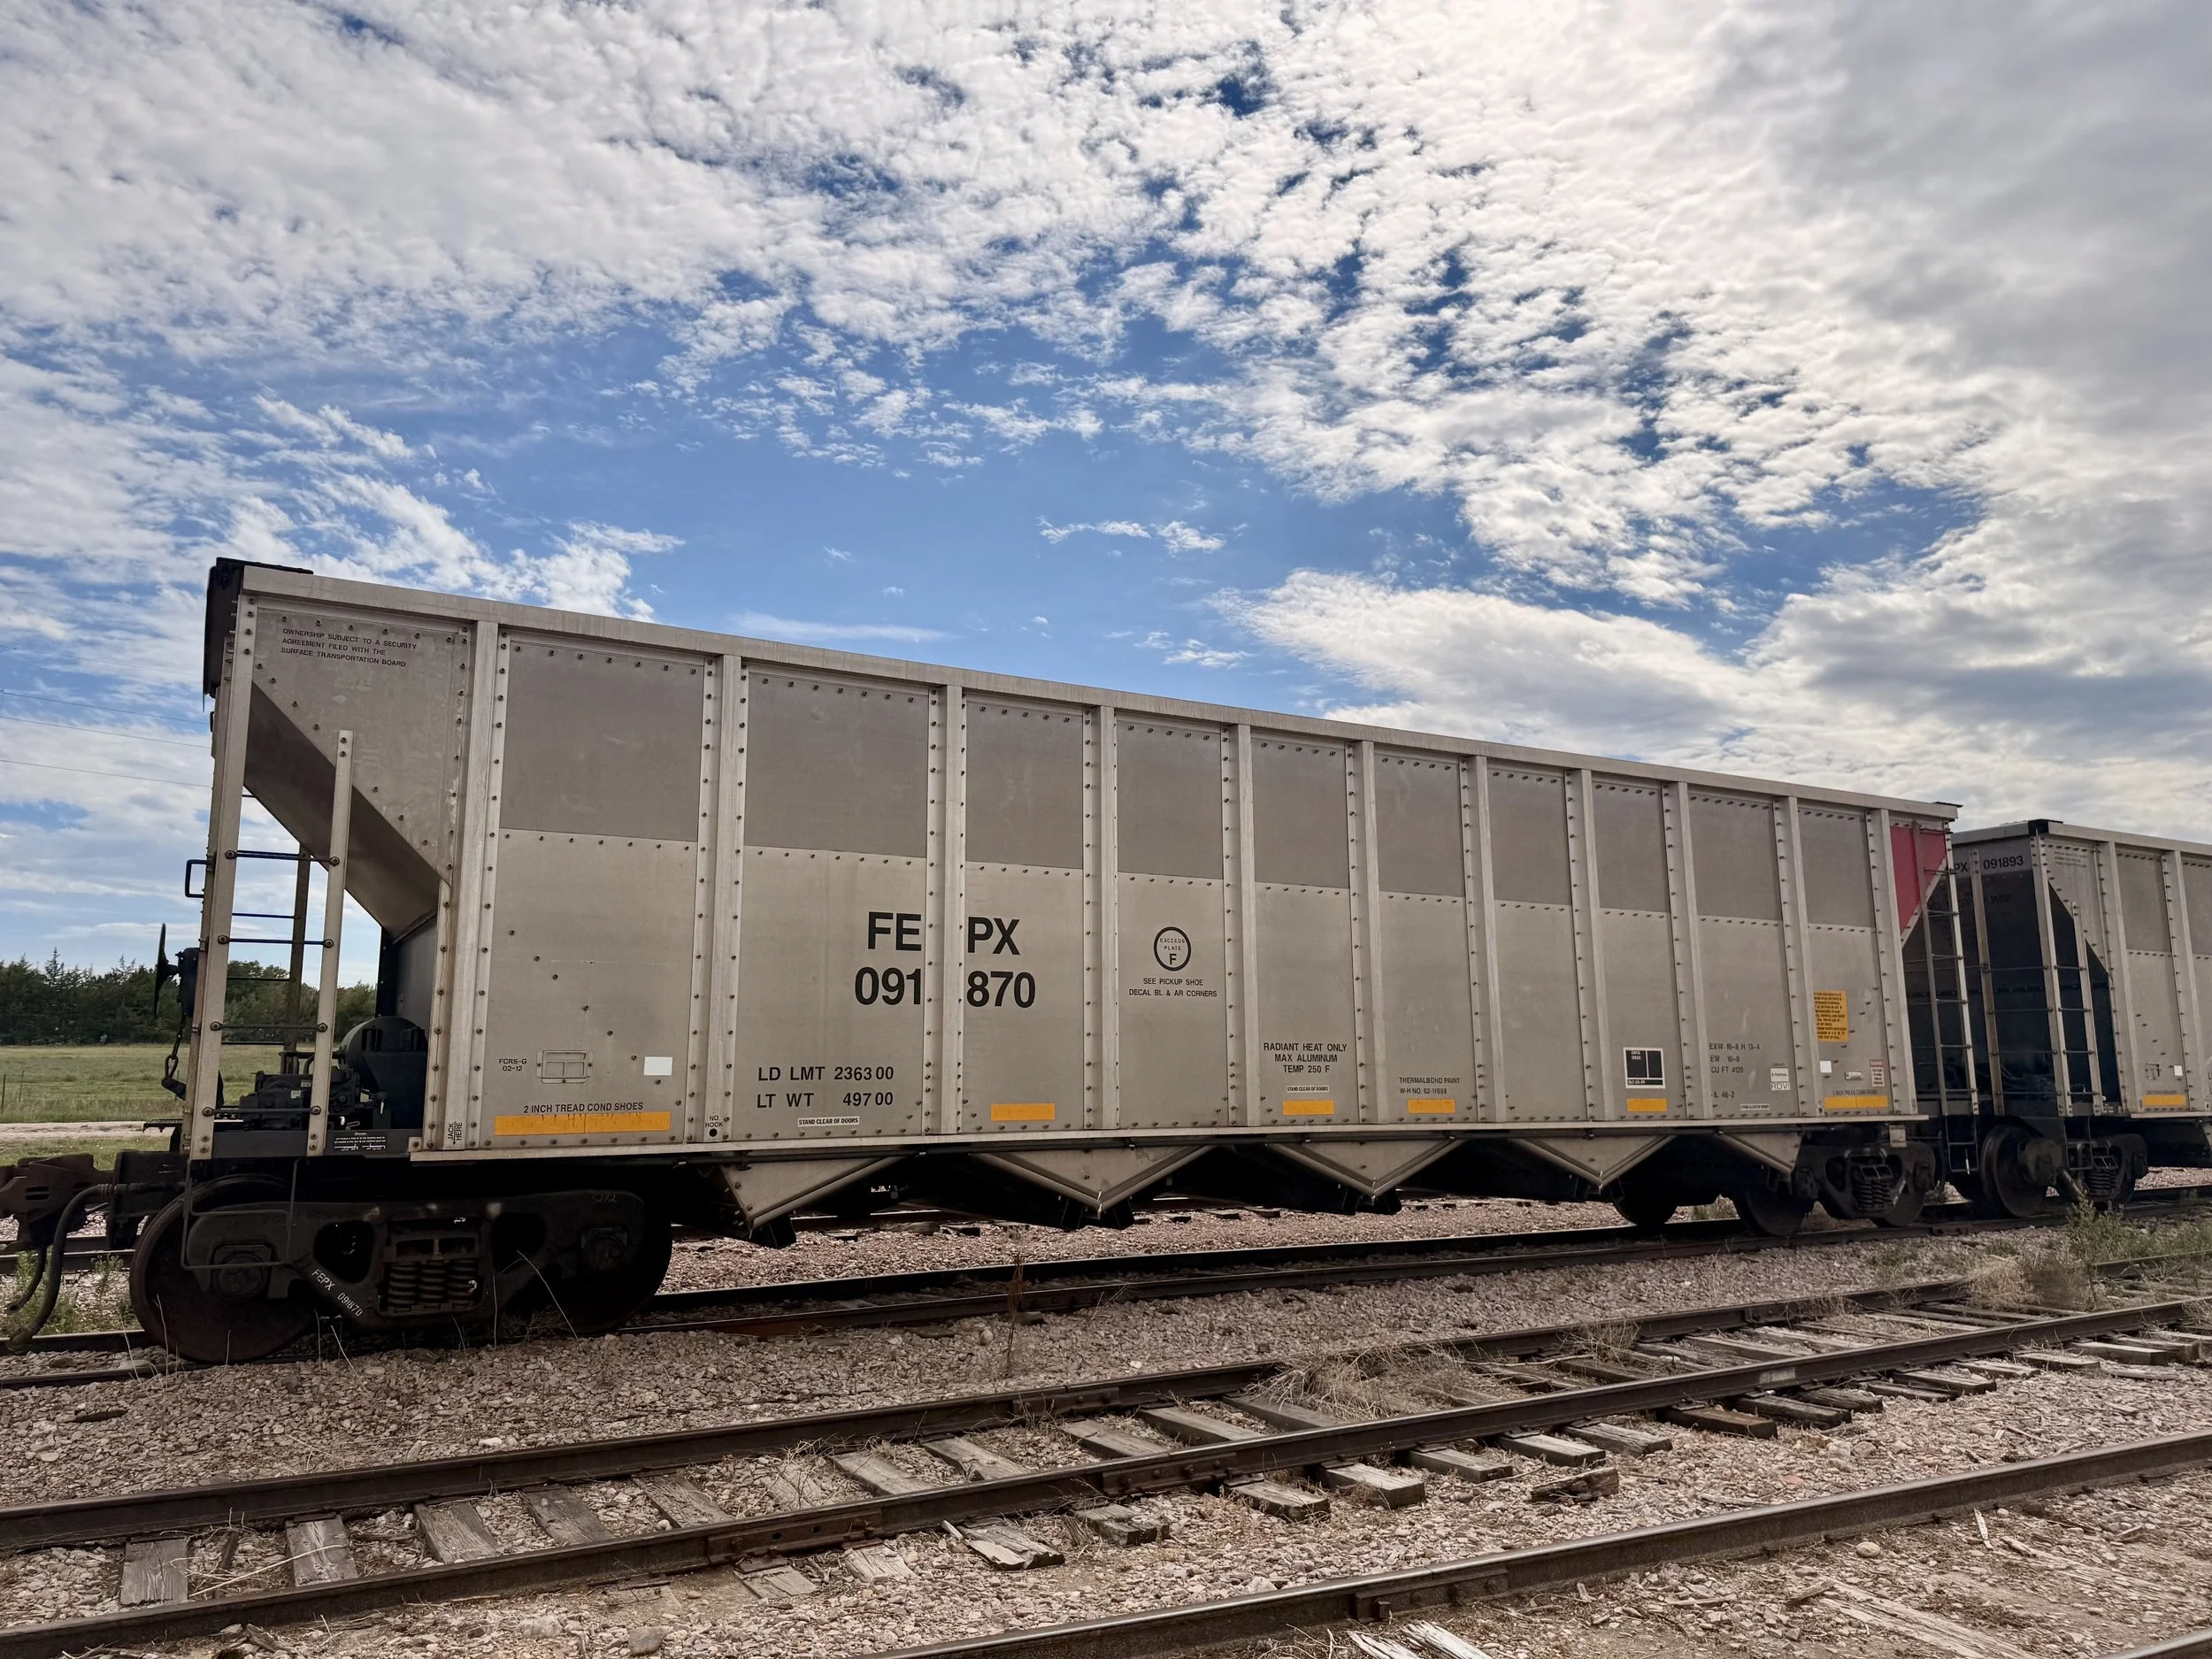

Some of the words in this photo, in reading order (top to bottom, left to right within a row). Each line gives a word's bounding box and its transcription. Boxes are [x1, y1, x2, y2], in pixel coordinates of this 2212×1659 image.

[281, 638, 325, 649] AGREEMENT
[282, 628, 324, 638] OWNERSHIP
[327, 634, 358, 643] SUBJECT
[383, 640, 417, 650] SECURITY
[280, 647, 313, 657] SURFACE
[317, 651, 379, 664] TRANSPORTATION
[1983, 855, 2024, 870] 091893
[1169, 953, 1177, 965] F
[855, 966, 921, 1005] 091
[966, 971, 1036, 1009] 870
[758, 1067, 780, 1081] LD
[790, 1066, 826, 1080] LMT
[1283, 1064, 1304, 1073] TEMP
[531, 1104, 552, 1113] INCH
[555, 1103, 585, 1112] TREAD
[587, 1102, 612, 1111] COND
[614, 1102, 643, 1110] SHOES
[757, 1094, 776, 1108] LT
[786, 1093, 814, 1107] WT
[311, 1269, 336, 1291] FEPX
[337, 1292, 363, 1317] 091870
